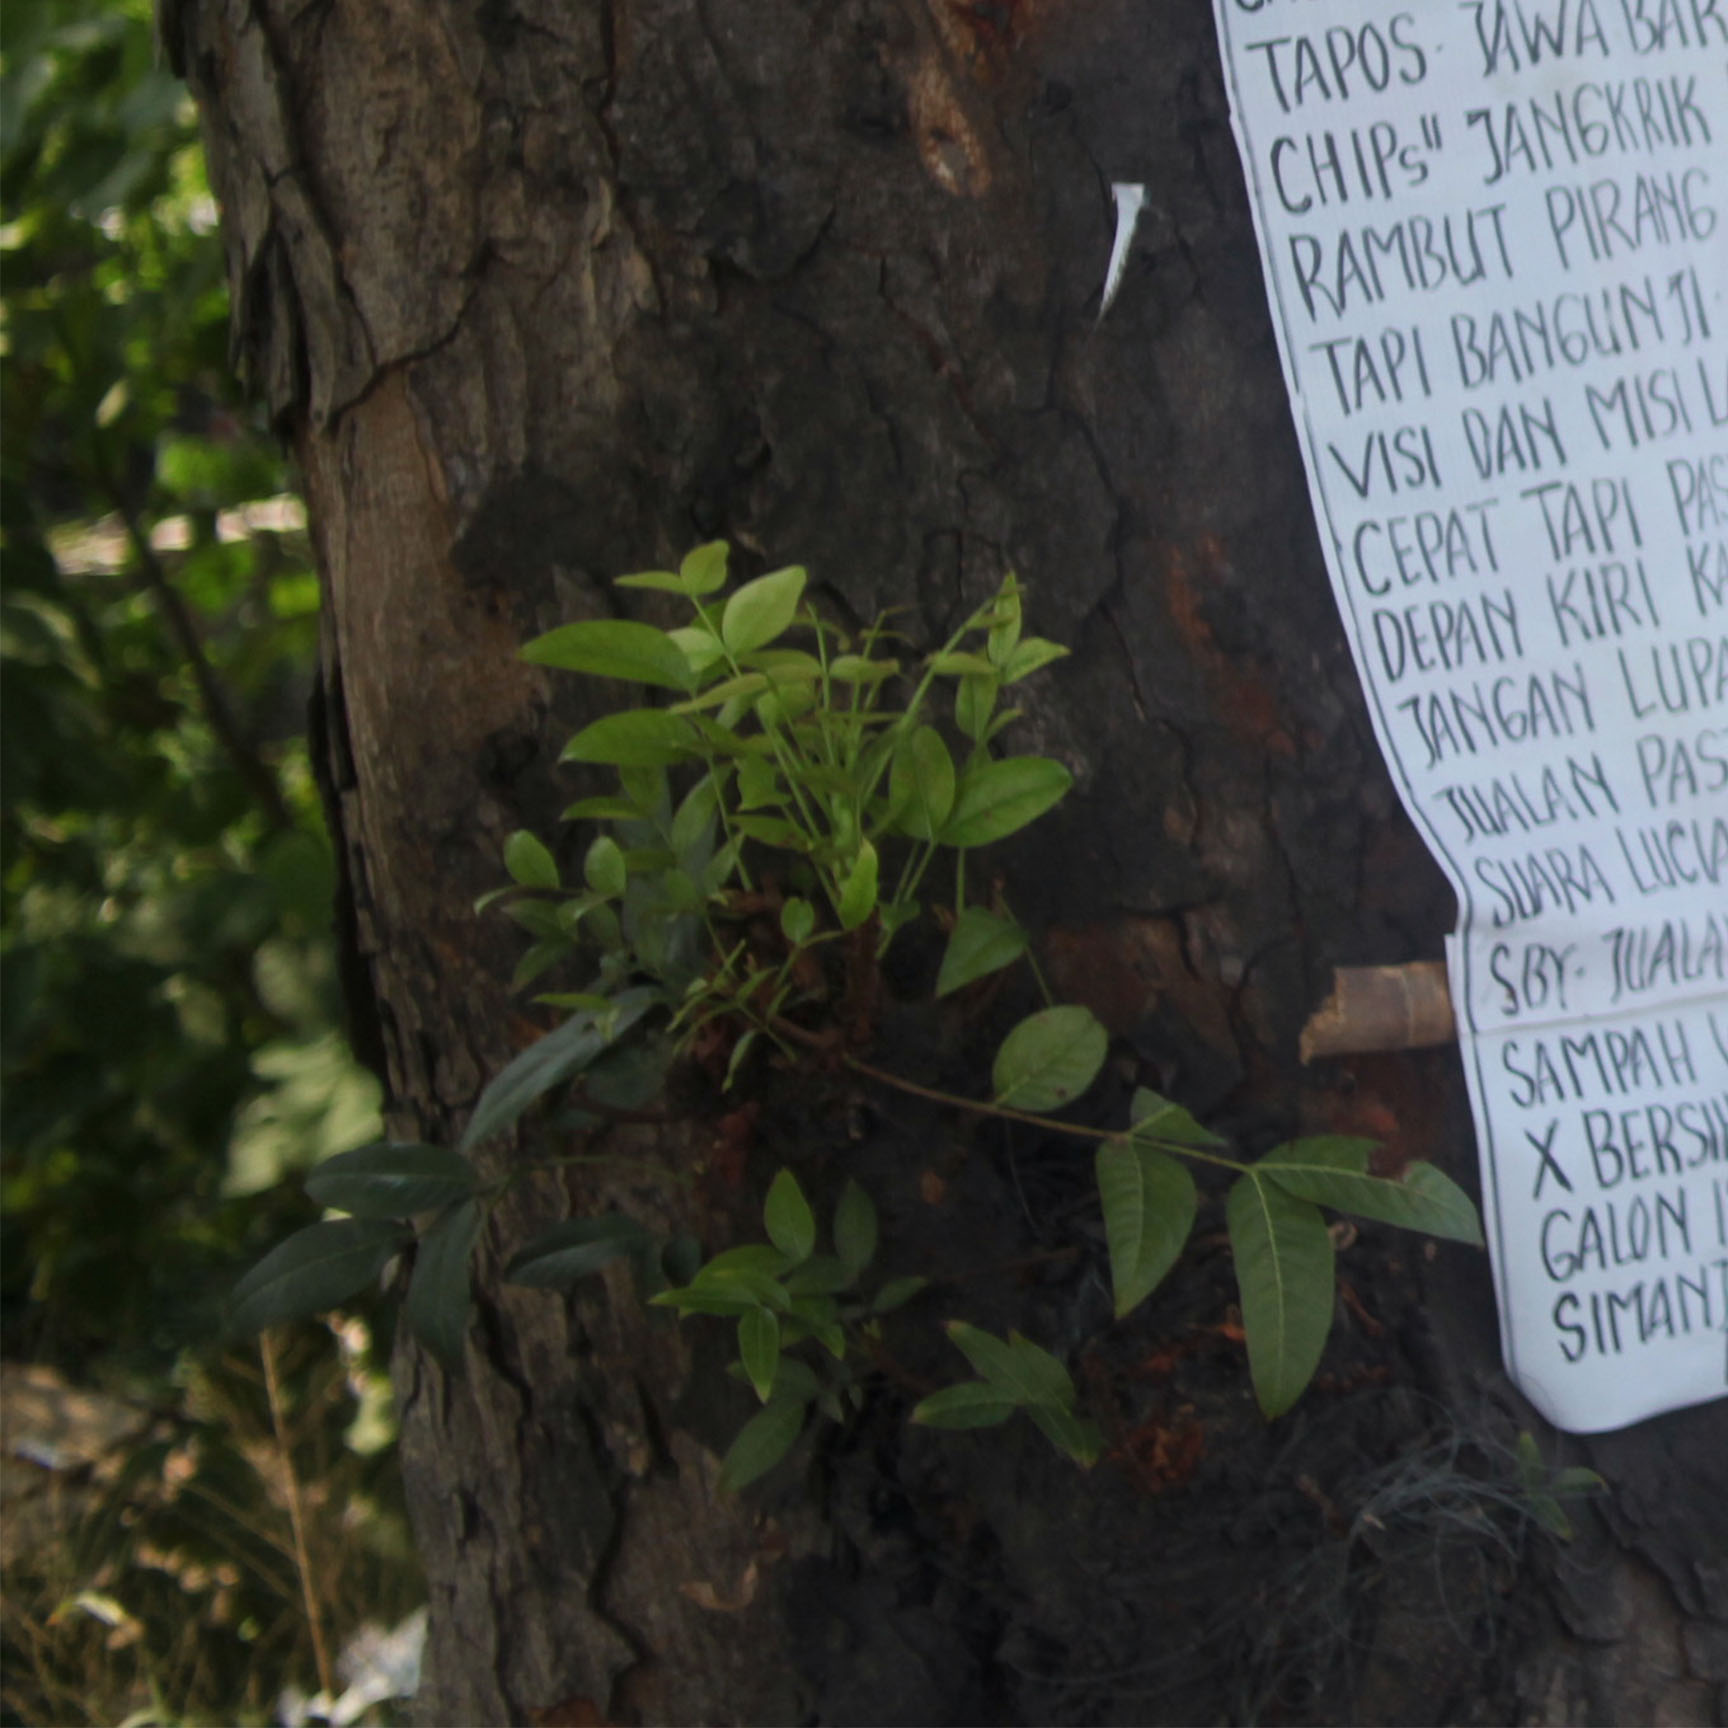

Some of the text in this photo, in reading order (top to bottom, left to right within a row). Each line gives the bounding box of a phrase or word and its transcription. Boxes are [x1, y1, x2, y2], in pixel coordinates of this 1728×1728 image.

[1245, 12, 1428, 114] TAPOS
[1464, 75, 1713, 186] JANGKRIK
[1288, 202, 1514, 324] RAMBUT
[1545, 168, 1718, 273] PIRANG
[1308, 325, 1432, 418] TAPI
[1327, 422, 1443, 501] VISI
[1462, 396, 1569, 480] DAN
[1585, 368, 1692, 452] MISI
[1353, 497, 1500, 598] CEPAT
[1519, 477, 1643, 564] TAPI
[1373, 587, 1524, 684] DEPAN
[1546, 557, 1661, 649] KIRI
[1396, 661, 1597, 772] JANGAN
[1431, 752, 1621, 846] JUALAN
[1473, 842, 1617, 929] SUARA
[1489, 941, 1580, 1017] SBY
[1502, 1017, 1699, 1109] SAMPAH
[1523, 1116, 1574, 1202] X
[1540, 1184, 1694, 1283] GALON
